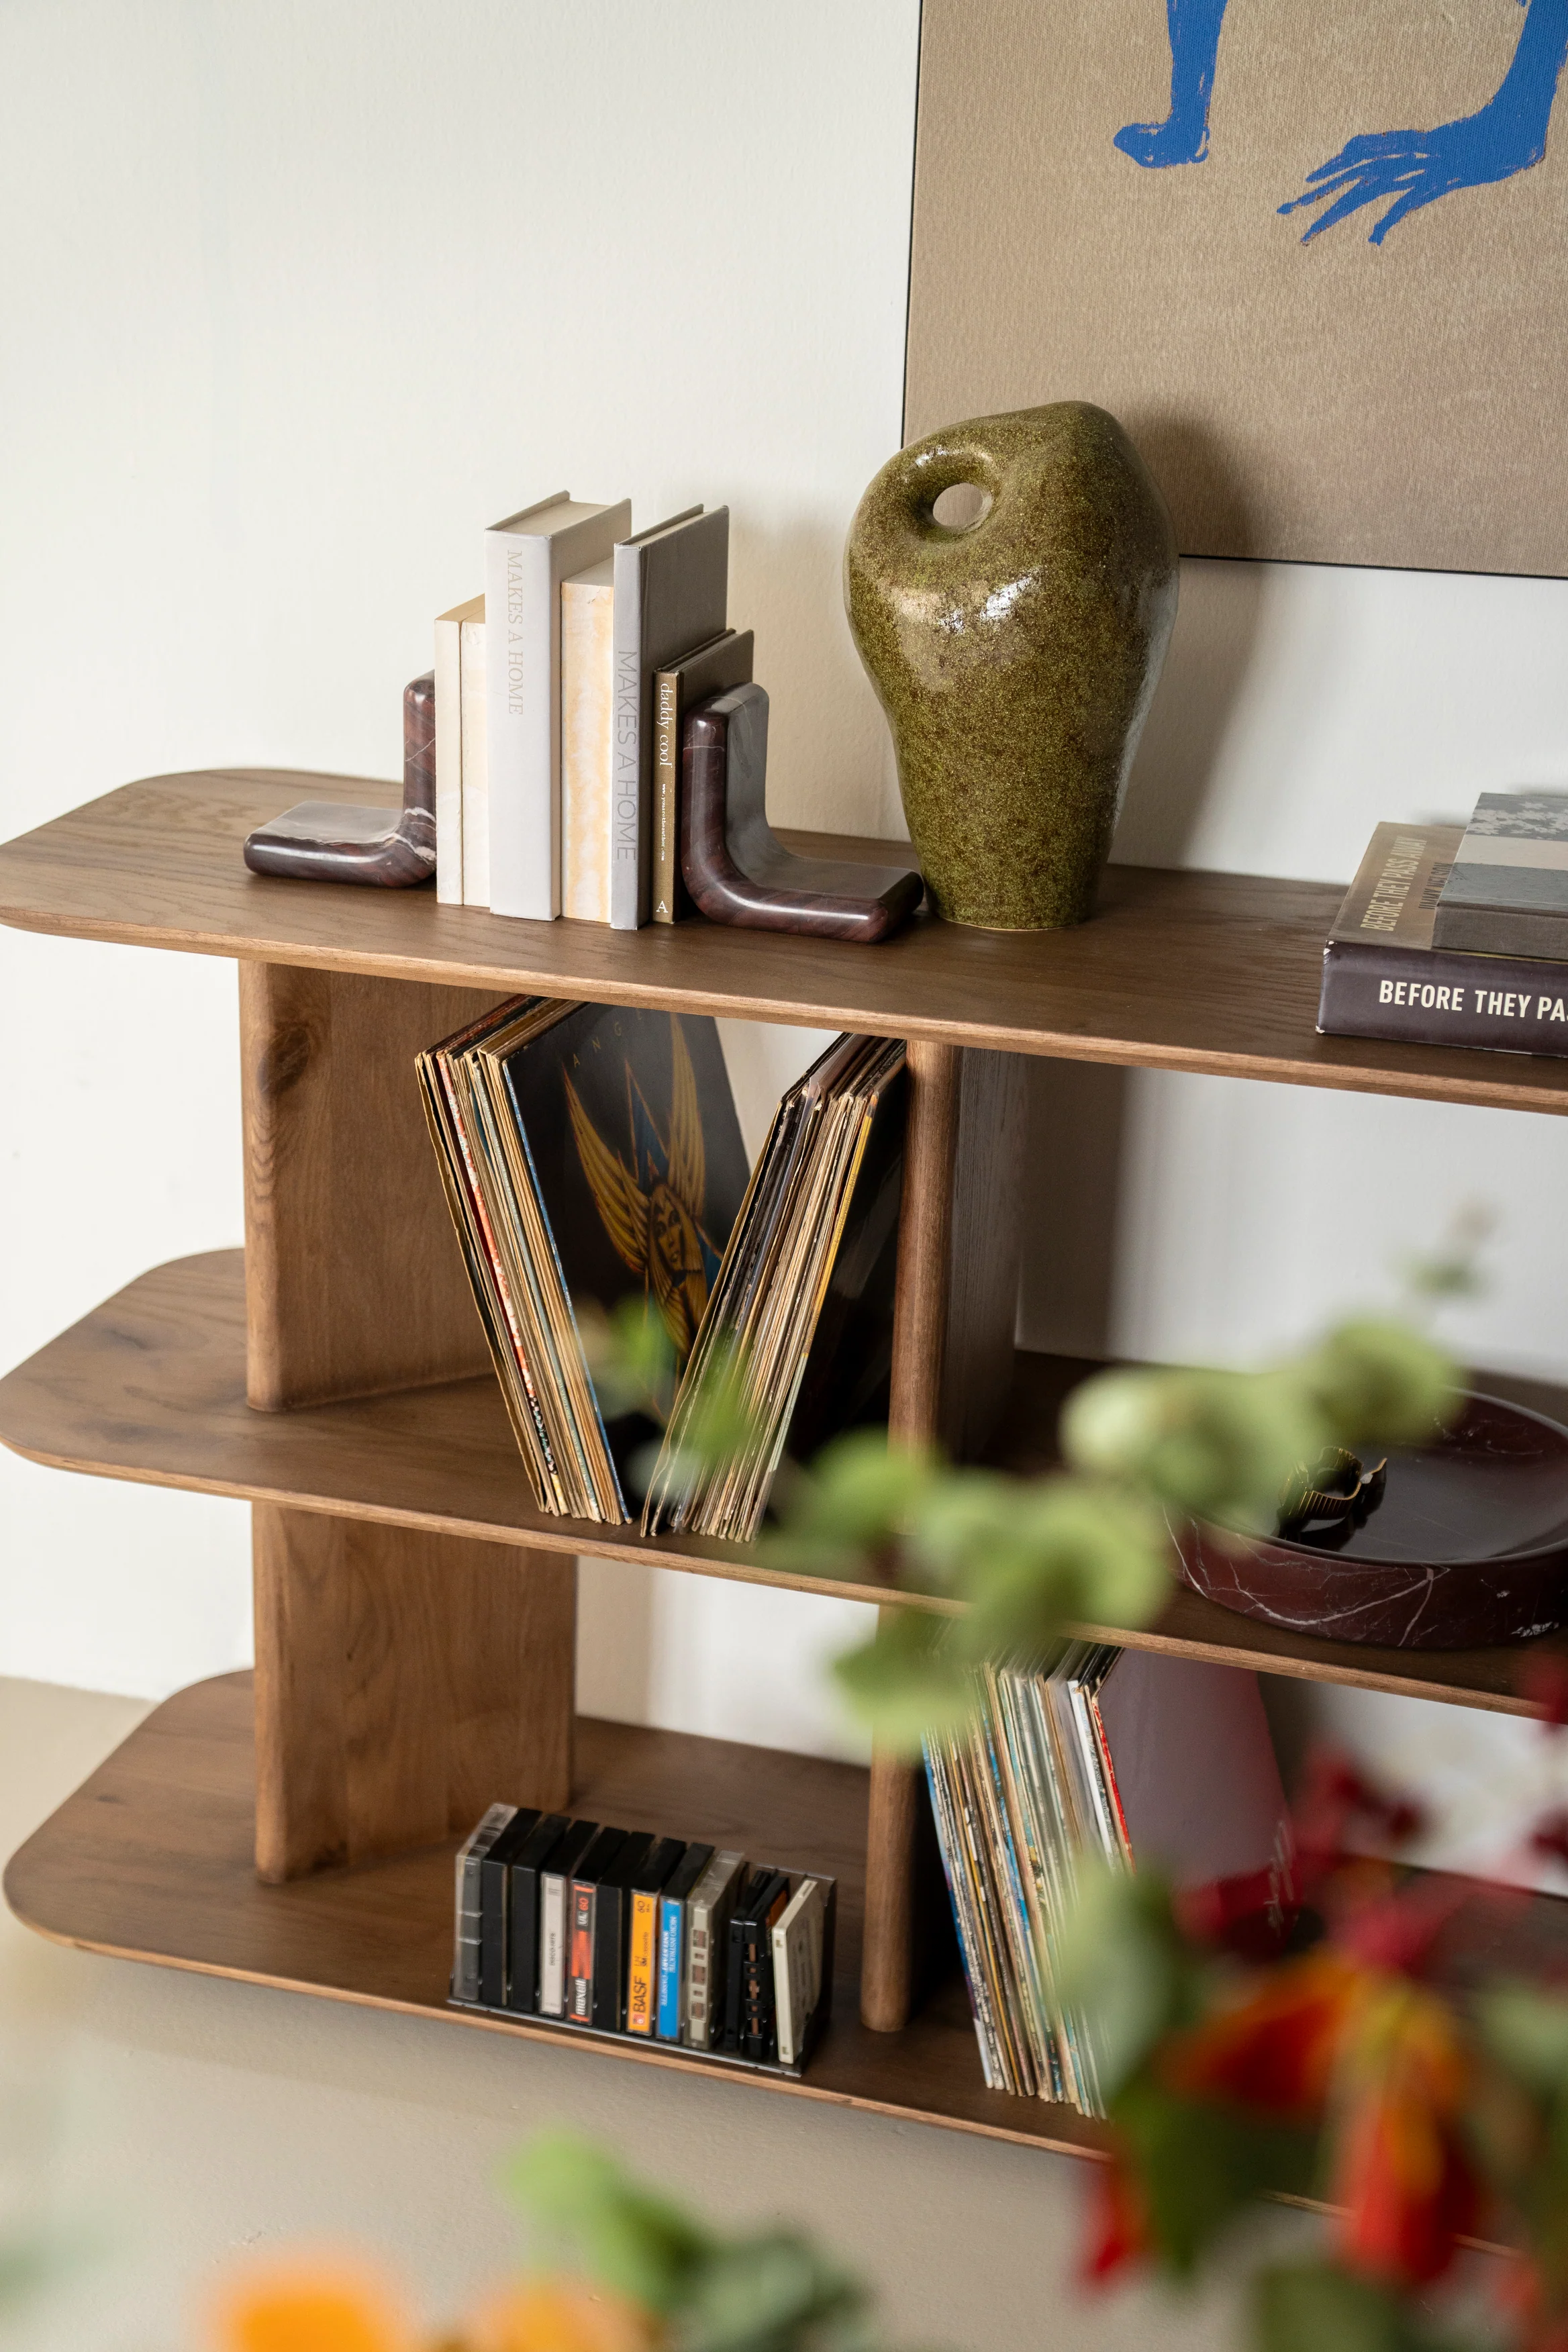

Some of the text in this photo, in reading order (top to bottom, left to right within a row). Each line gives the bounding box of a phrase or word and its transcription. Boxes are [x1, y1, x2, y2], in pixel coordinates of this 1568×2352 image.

[507, 550, 524, 715] MAKES A HOME
[656, 683, 673, 768] daddy cool
[617, 650, 637, 861] MAKES A HOME
[1360, 836, 1427, 932] BEFORE THEY PASS AWAY
[656, 900, 669, 914] A
[1379, 980, 1568, 1023] BEFORE THEY PA
[578, 1897, 589, 1911] 60
[638, 1900, 645, 1913] 60
[669, 1916, 677, 1937] MICRO
[575, 1978, 587, 2016] maxell
[633, 1975, 648, 2013] BASF
